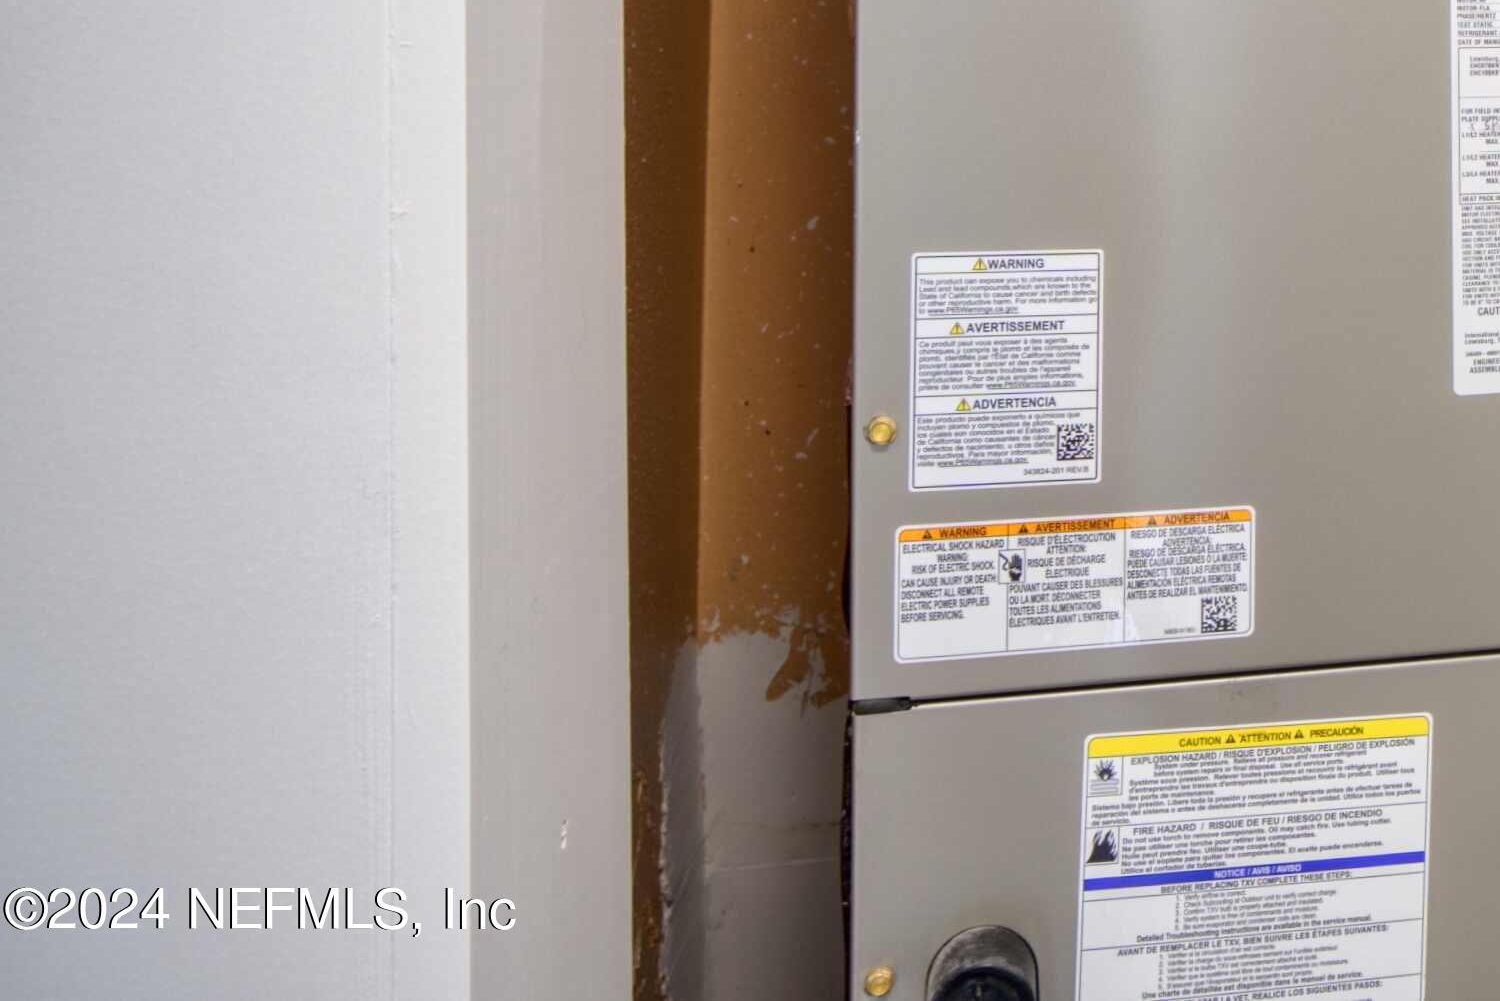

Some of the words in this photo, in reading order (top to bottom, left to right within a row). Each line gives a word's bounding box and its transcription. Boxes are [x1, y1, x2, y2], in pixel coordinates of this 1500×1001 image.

[987, 258, 1044, 269] WARNING
[966, 320, 1064, 332] AVERTISSEMENT
[972, 396, 1056, 409] ADVERTENCIA
[1164, 512, 1229, 524] ADVERTENCIA
[939, 526, 986, 537] WARNING
[1037, 519, 1114, 532] AVERTISSEMENT
[903, 542, 946, 554] ELECTRICAL
[949, 540, 972, 550] SHOCK
[975, 538, 1004, 549] HAZARD
[1018, 536, 1045, 546] RISQUE
[911, 564, 926, 574] RISK
[928, 564, 936, 573] OF
[938, 562, 970, 572] ELECTRIC
[1027, 557, 1053, 567] RISQUE
[1055, 556, 1064, 565] DE
[901, 579, 914, 588] CAN
[917, 577, 937, 587] CAUSE
[940, 575, 961, 585] INJURY
[964, 575, 972, 584] OR
[1008, 582, 1039, 593] POUVANT
[1042, 580, 1068, 591] CAUSER
[1070, 579, 1083, 589] DES
[901, 588, 941, 599] DISCONNECT
[944, 587, 954, 596] ALL
[957, 585, 984, 596] REMOTE
[901, 600, 932, 611] ELECTRIC
[934, 599, 957, 608] POWER
[959, 596, 989, 607] SUPPLIES
[1009, 595, 1019, 604] OU
[1021, 594, 1028, 603] LA
[1009, 605, 1035, 616] TOUTES
[1037, 604, 1048, 614] LES
[1050, 600, 1101, 613] ALIMENTATIONS
[901, 612, 926, 622] BEFORE
[1178, 735, 1221, 747] CAUTION
[1240, 731, 1291, 743] ATTENTION
[1309, 725, 1364, 737] PRECAUCIÓN
[1130, 754, 1179, 765] EXPLOSION
[1182, 752, 1216, 761] HAZARD
[1223, 749, 1254, 759] RISQUE
[1318, 743, 1354, 752] PELIGRO
[1133, 827, 1154, 835] FIRE
[1157, 823, 1196, 833] HAZARD
[1208, 819, 1244, 830] RISQUE
[1247, 818, 1259, 826] DE
[1262, 817, 1279, 825] FEU
[1287, 813, 1321, 823] RIESGO
[1324, 812, 1336, 820] DE
[1339, 809, 1382, 819] INCENDIO
[1213, 868, 1244, 878] NOTICE
[1252, 866, 1270, 875] AVIS
[1276, 863, 1301, 873] AVISO
[1160, 884, 1192, 893] BEFORE
[1194, 880, 1238, 890] REPLACING
[1241, 878, 1254, 886] TXV
[1257, 875, 1297, 885] COMPLETE
[1300, 873, 1323, 882] THESE
[1117, 947, 1143, 956] AVANT
[1159, 941, 1208, 952] REMPLACER
[1243, 936, 1261, 944] BIEN
[1264, 933, 1292, 942] SUIVRE
[1295, 931, 1310, 939] LES
